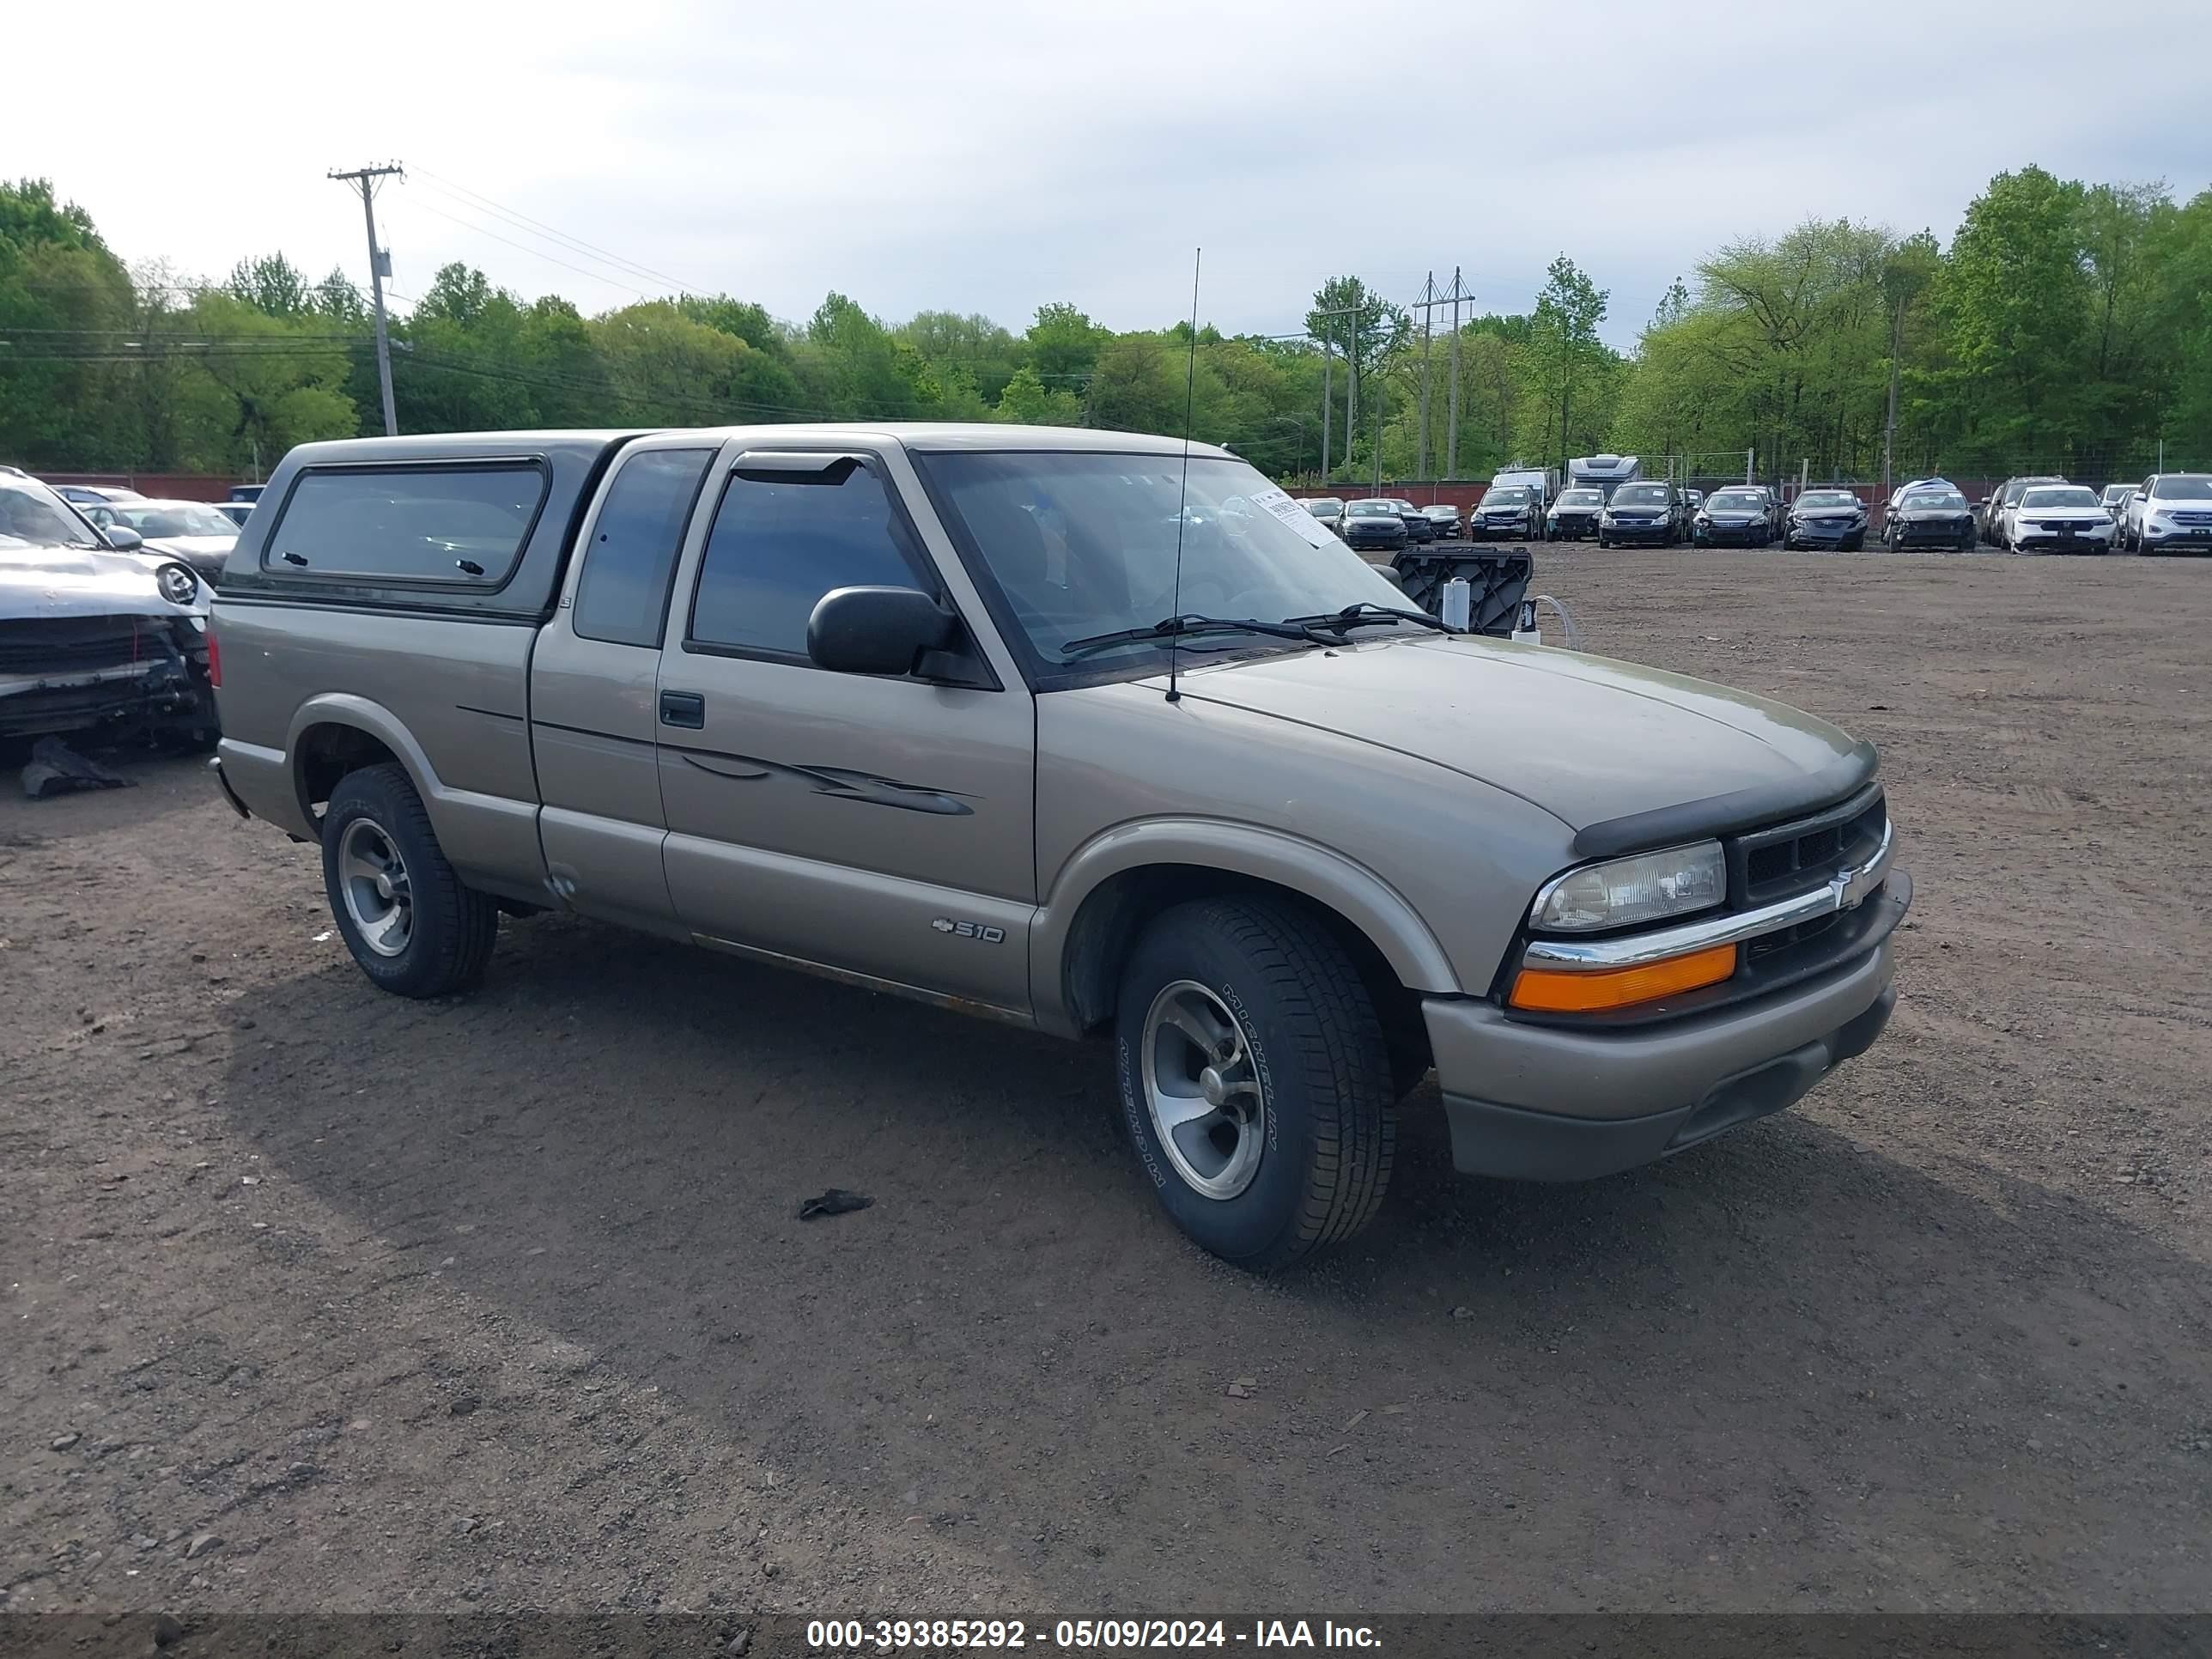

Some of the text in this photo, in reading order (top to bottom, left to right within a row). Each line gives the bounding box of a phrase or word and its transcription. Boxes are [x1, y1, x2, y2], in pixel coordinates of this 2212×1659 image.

[954, 921, 1006, 944] S10
[1121, 1036, 1167, 1188] MICHELIN
[1222, 982, 1278, 1152] MICHELIN
